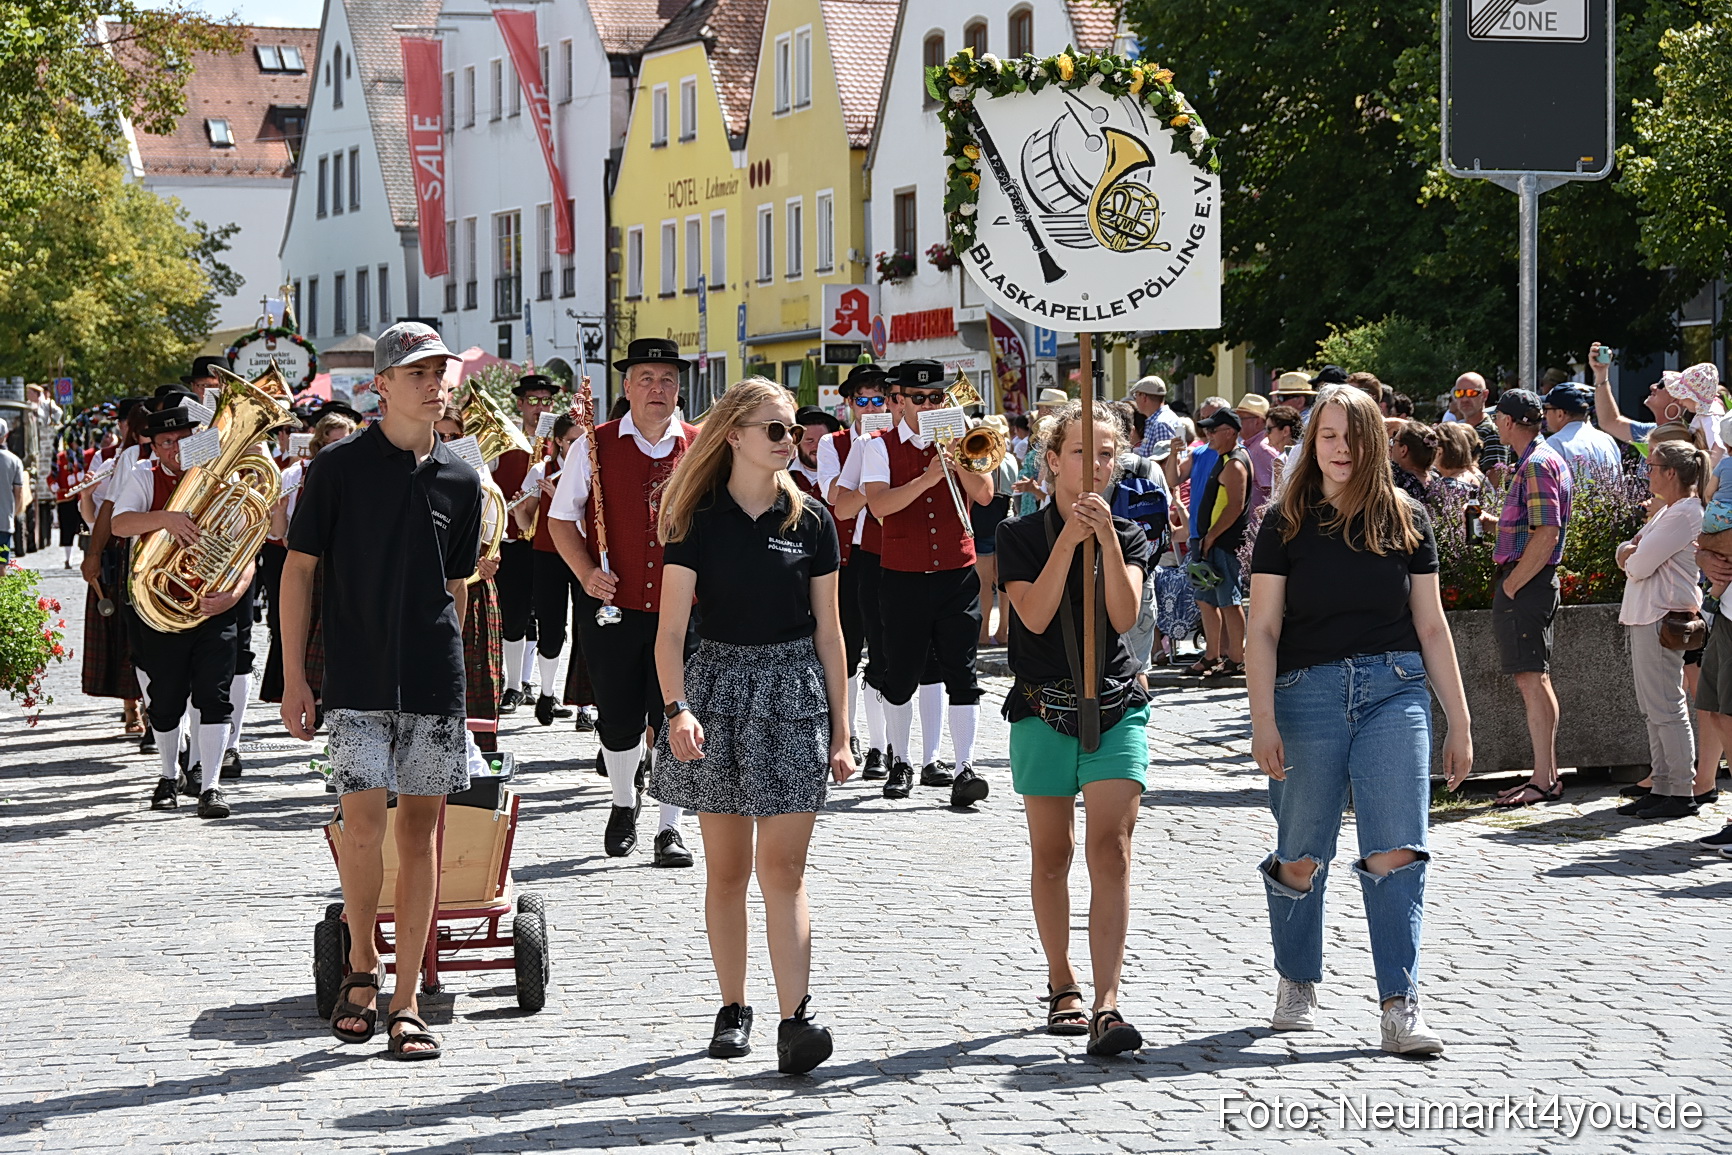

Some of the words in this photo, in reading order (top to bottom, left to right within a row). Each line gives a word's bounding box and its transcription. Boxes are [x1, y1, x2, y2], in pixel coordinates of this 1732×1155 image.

[1499, 10, 1558, 31] ZONE
[413, 114, 443, 201] SALE
[668, 177, 698, 209] HOTEL
[970, 243, 1127, 322] BLASKAPELLE
[1127, 223, 1206, 309] PÖLLING
[994, 336, 1019, 355] EIS
